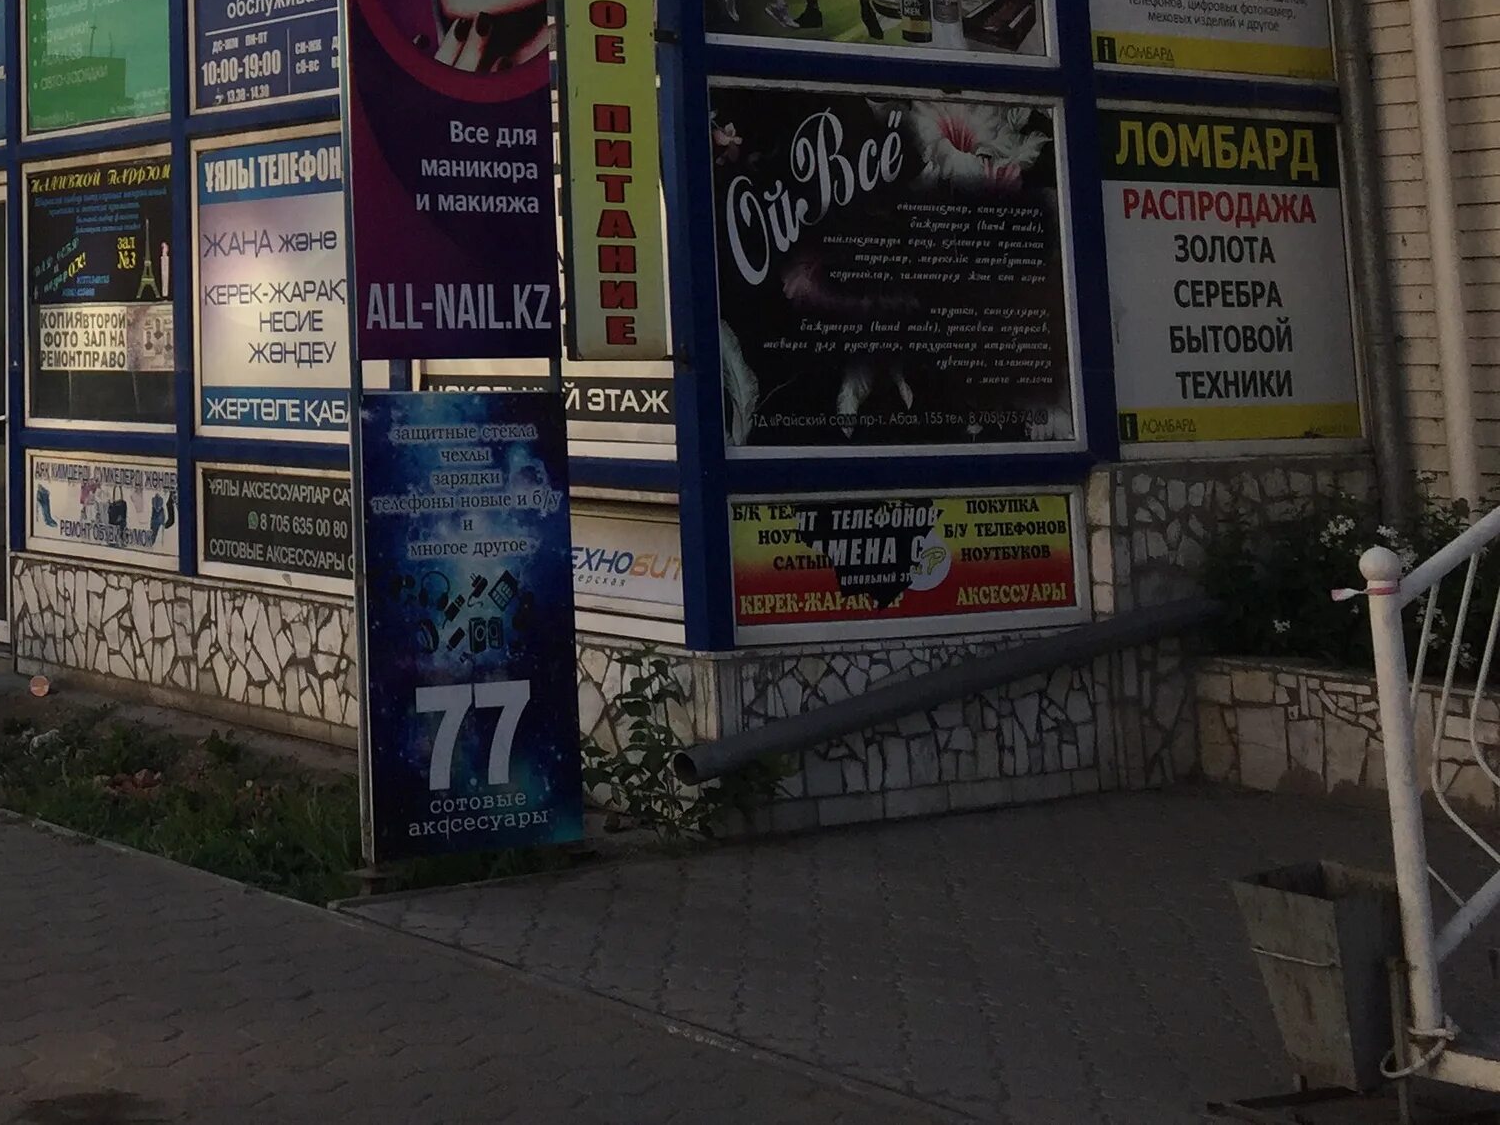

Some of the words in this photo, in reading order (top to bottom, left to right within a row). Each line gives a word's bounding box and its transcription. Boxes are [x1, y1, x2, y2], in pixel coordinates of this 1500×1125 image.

[201, 49, 281, 86] 10:00-19:00
[450, 120, 489, 144] Все
[496, 125, 537, 148] для
[1116, 120, 1319, 181] ЛОМБАРД
[421, 158, 538, 183] маникюра
[415, 193, 430, 212] и
[438, 193, 540, 215] макияжа
[726, 175, 804, 286] Ой
[790, 107, 904, 226] Всё
[1122, 188, 1317, 229] РАСПРОДАЖА
[593, 103, 638, 345] ПИТАНИЕ
[203, 230, 273, 258] ЖАҢА
[1174, 234, 1276, 264] ЗОЛОТА
[205, 279, 346, 306] КЕРЕК-ЖАРАҚ
[1174, 280, 1283, 308] СЕРЕБРА
[82, 308, 126, 328] ВТОРОЙ
[366, 282, 551, 330] ALL-NAIL.KZ
[41, 310, 82, 329] КОПИЯ
[259, 310, 323, 332] НЕСИЕ
[44, 330, 78, 348] ФОТО
[84, 329, 106, 348] ЗАЛ
[110, 328, 125, 347] НА
[1170, 316, 1293, 354] БЫТОВОЙ
[41, 349, 82, 368] РЕМОНТ
[82, 349, 126, 368] ПРАВО
[249, 341, 336, 368] ЖӨНДЕУ
[1175, 370, 1293, 400] ТЕХНИКИ
[207, 397, 300, 422] ЖЕРТӨЛЕ
[587, 387, 670, 415] ЭТАЖ
[393, 425, 477, 443] защитные
[441, 448, 490, 463] чехлы
[242, 480, 330, 506] АКСЕССУАРЛАР
[432, 471, 500, 489] зарядки
[372, 491, 454, 515] телефоны
[459, 493, 511, 509] новые
[517, 494, 527, 506] и
[533, 489, 562, 511] б/у
[966, 497, 1039, 515] ПОКУПКА
[260, 512, 267, 531] 8
[270, 513, 291, 533] 705
[293, 516, 313, 536] 635
[316, 519, 330, 537] 00
[333, 520, 348, 540] 80
[944, 522, 970, 540] Б/У
[975, 520, 1067, 539] ТЕЛЕФОНОВ
[209, 537, 264, 562] СОТОВЫЕ
[266, 543, 345, 572] АКСЕССУАРЫ
[410, 542, 468, 557] многое
[472, 539, 528, 558] другое
[961, 545, 1051, 563] НОУТБУКОВ
[956, 582, 1067, 607] АКСЕССУАРЫ
[415, 679, 531, 791] 77
[430, 792, 527, 814] сотовые
